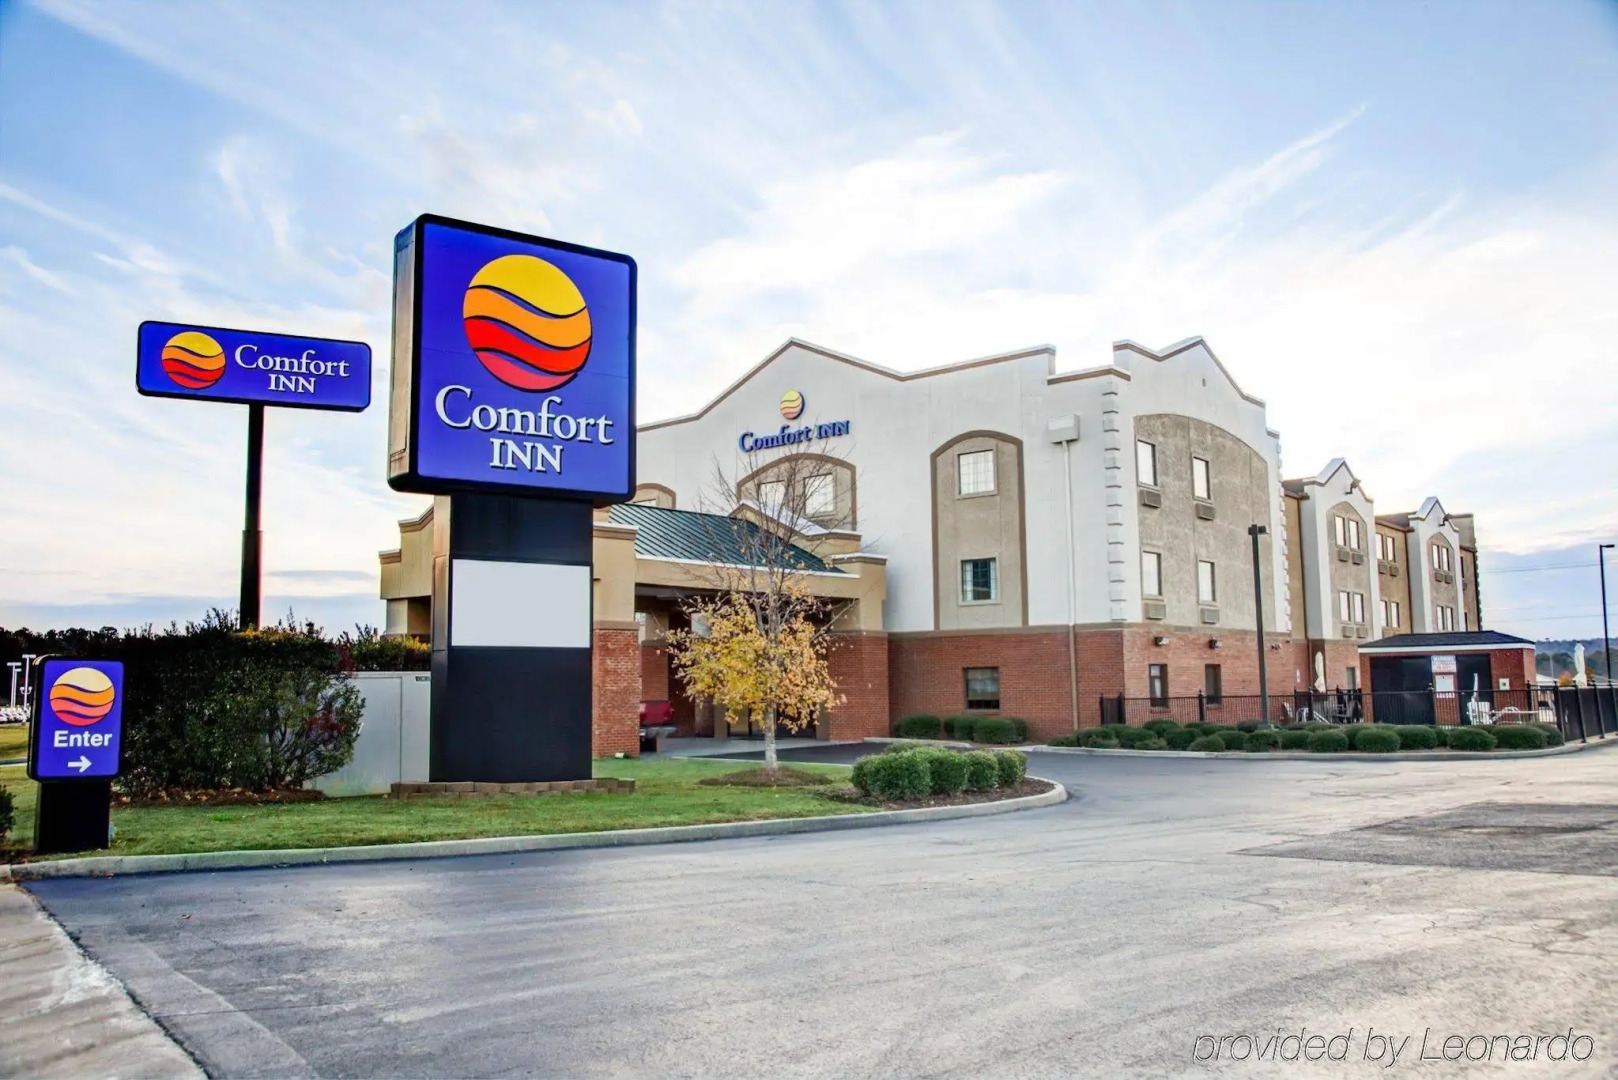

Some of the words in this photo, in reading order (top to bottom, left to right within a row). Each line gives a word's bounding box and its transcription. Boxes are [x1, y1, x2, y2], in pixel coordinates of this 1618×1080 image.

[234, 344, 350, 377] Comfort
[268, 374, 316, 393] INN
[435, 385, 614, 443] Comfort
[739, 424, 812, 452] Comfort
[815, 420, 850, 440] INN
[489, 437, 563, 473] INN
[54, 730, 113, 747] Enter
